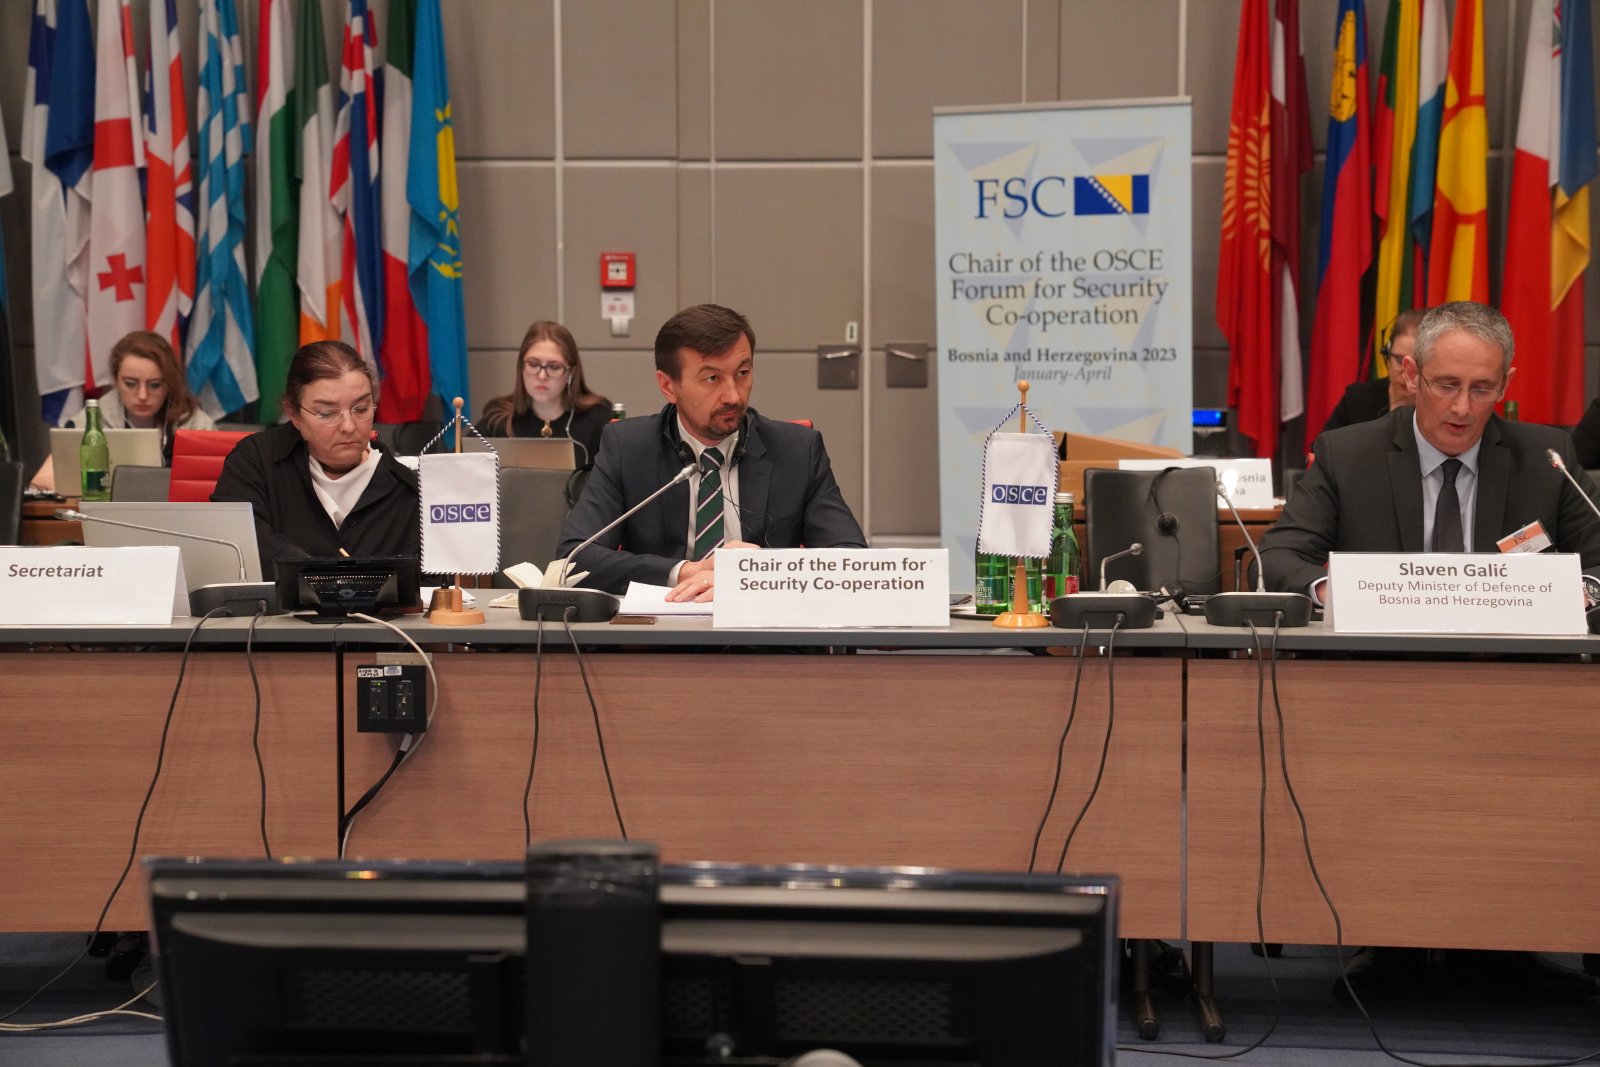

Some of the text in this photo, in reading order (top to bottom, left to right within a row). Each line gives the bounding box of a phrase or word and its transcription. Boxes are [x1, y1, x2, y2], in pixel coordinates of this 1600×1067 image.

[974, 176, 1066, 219] FSC
[948, 249, 1164, 274] Chair of the OSCE
[951, 276, 1169, 304] Forum for Security
[986, 303, 1139, 332] Co-operation
[947, 347, 1177, 366] Bosnia and Herzegovina 2023
[1013, 365, 1113, 385] January-April
[8, 563, 104, 578] Secretariat
[739, 557, 927, 572] Chair of the Forum for
[1399, 562, 1508, 578] Slaven Galić
[739, 576, 925, 594] Security Co-operation
[1358, 580, 1553, 593] Deputy Minister of Defence of
[1379, 594, 1533, 609] Bosnia and Herzegovina
